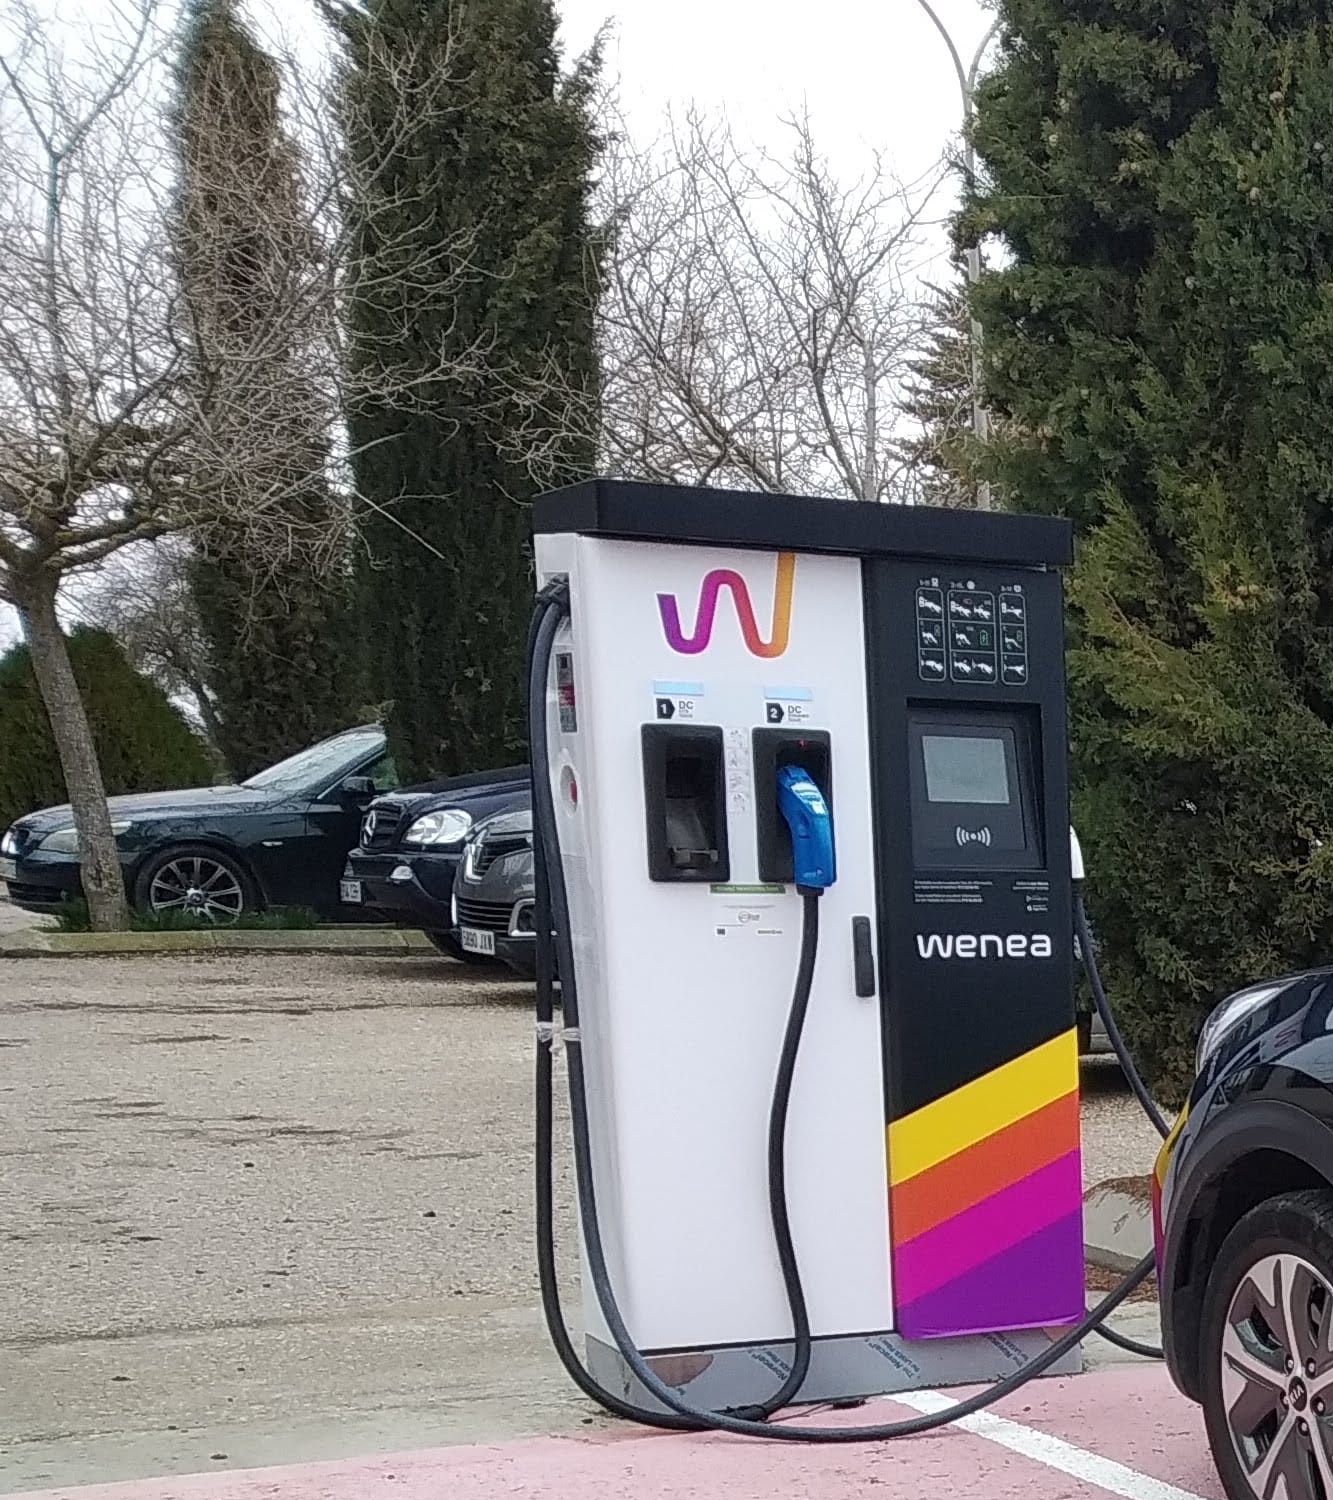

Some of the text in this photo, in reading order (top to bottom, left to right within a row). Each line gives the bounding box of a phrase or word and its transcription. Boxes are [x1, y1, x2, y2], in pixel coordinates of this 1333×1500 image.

[661, 701, 694, 714] 1 DC
[771, 708, 778, 718] 2
[788, 706, 802, 714] DC
[916, 934, 1052, 958] wenea
[1290, 1385, 1304, 1404] KIA
